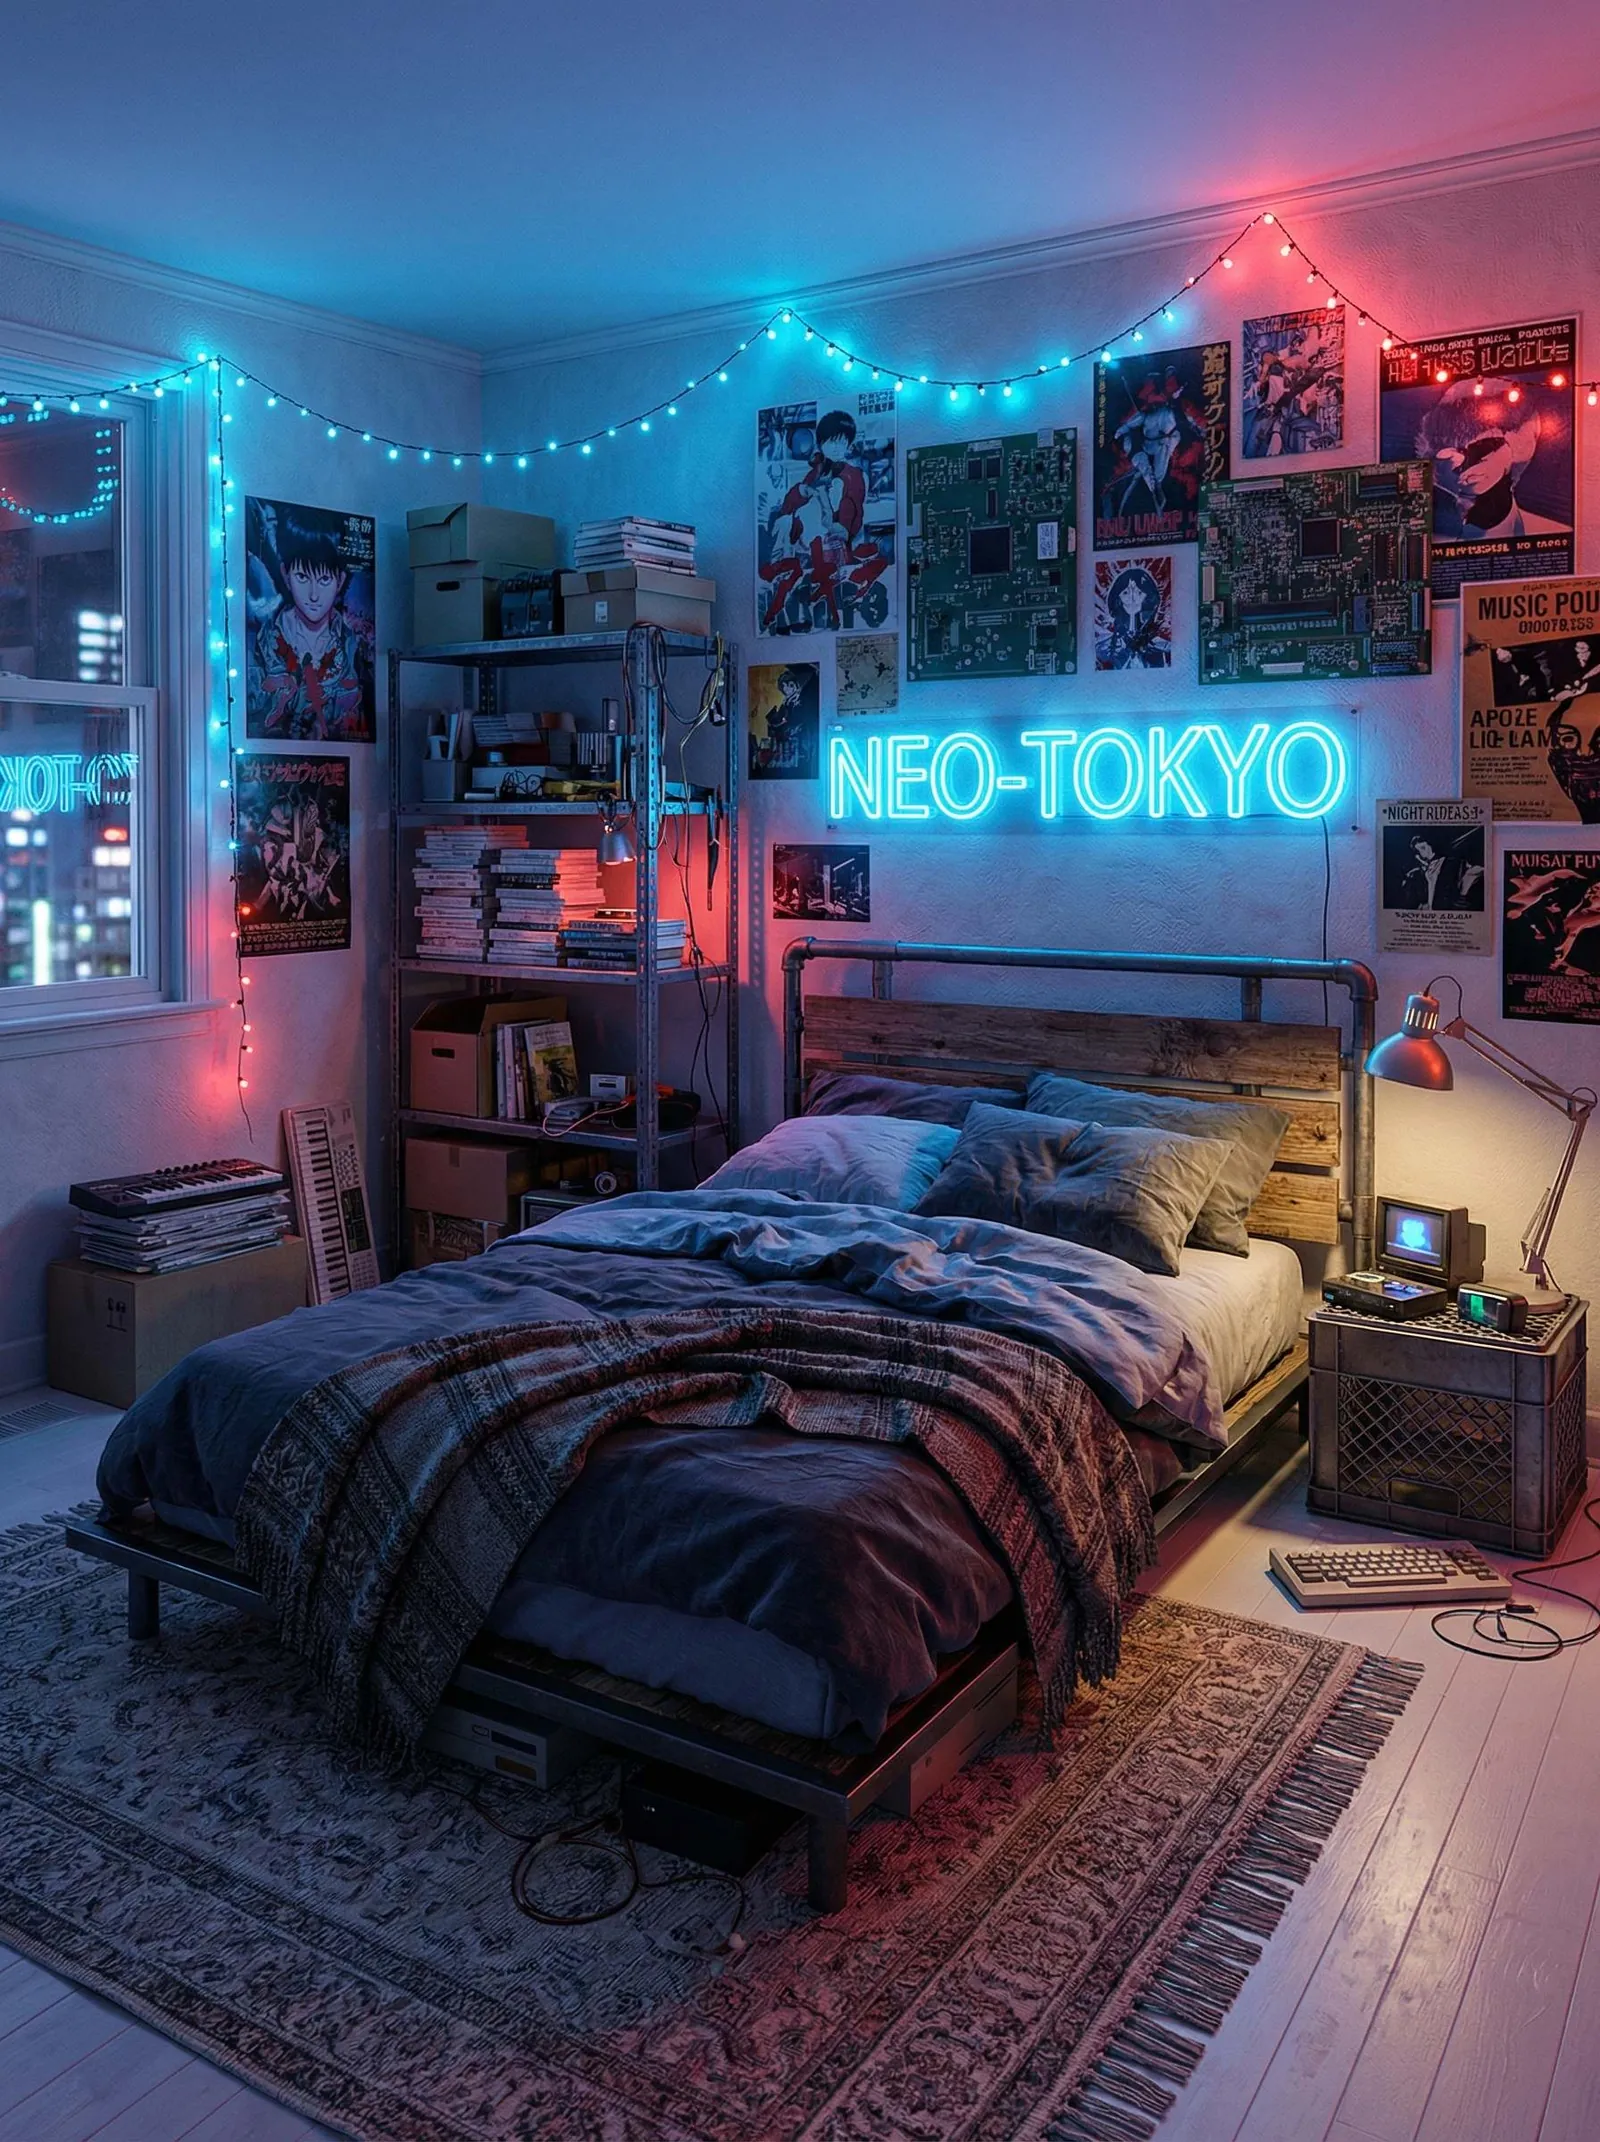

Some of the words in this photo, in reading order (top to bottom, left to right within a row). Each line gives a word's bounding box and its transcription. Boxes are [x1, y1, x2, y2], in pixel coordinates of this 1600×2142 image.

[1479, 594, 1548, 621] MUSIC
[830, 722, 1347, 821] NEO-TOKYO
[1388, 806, 1424, 820] NIGHT
